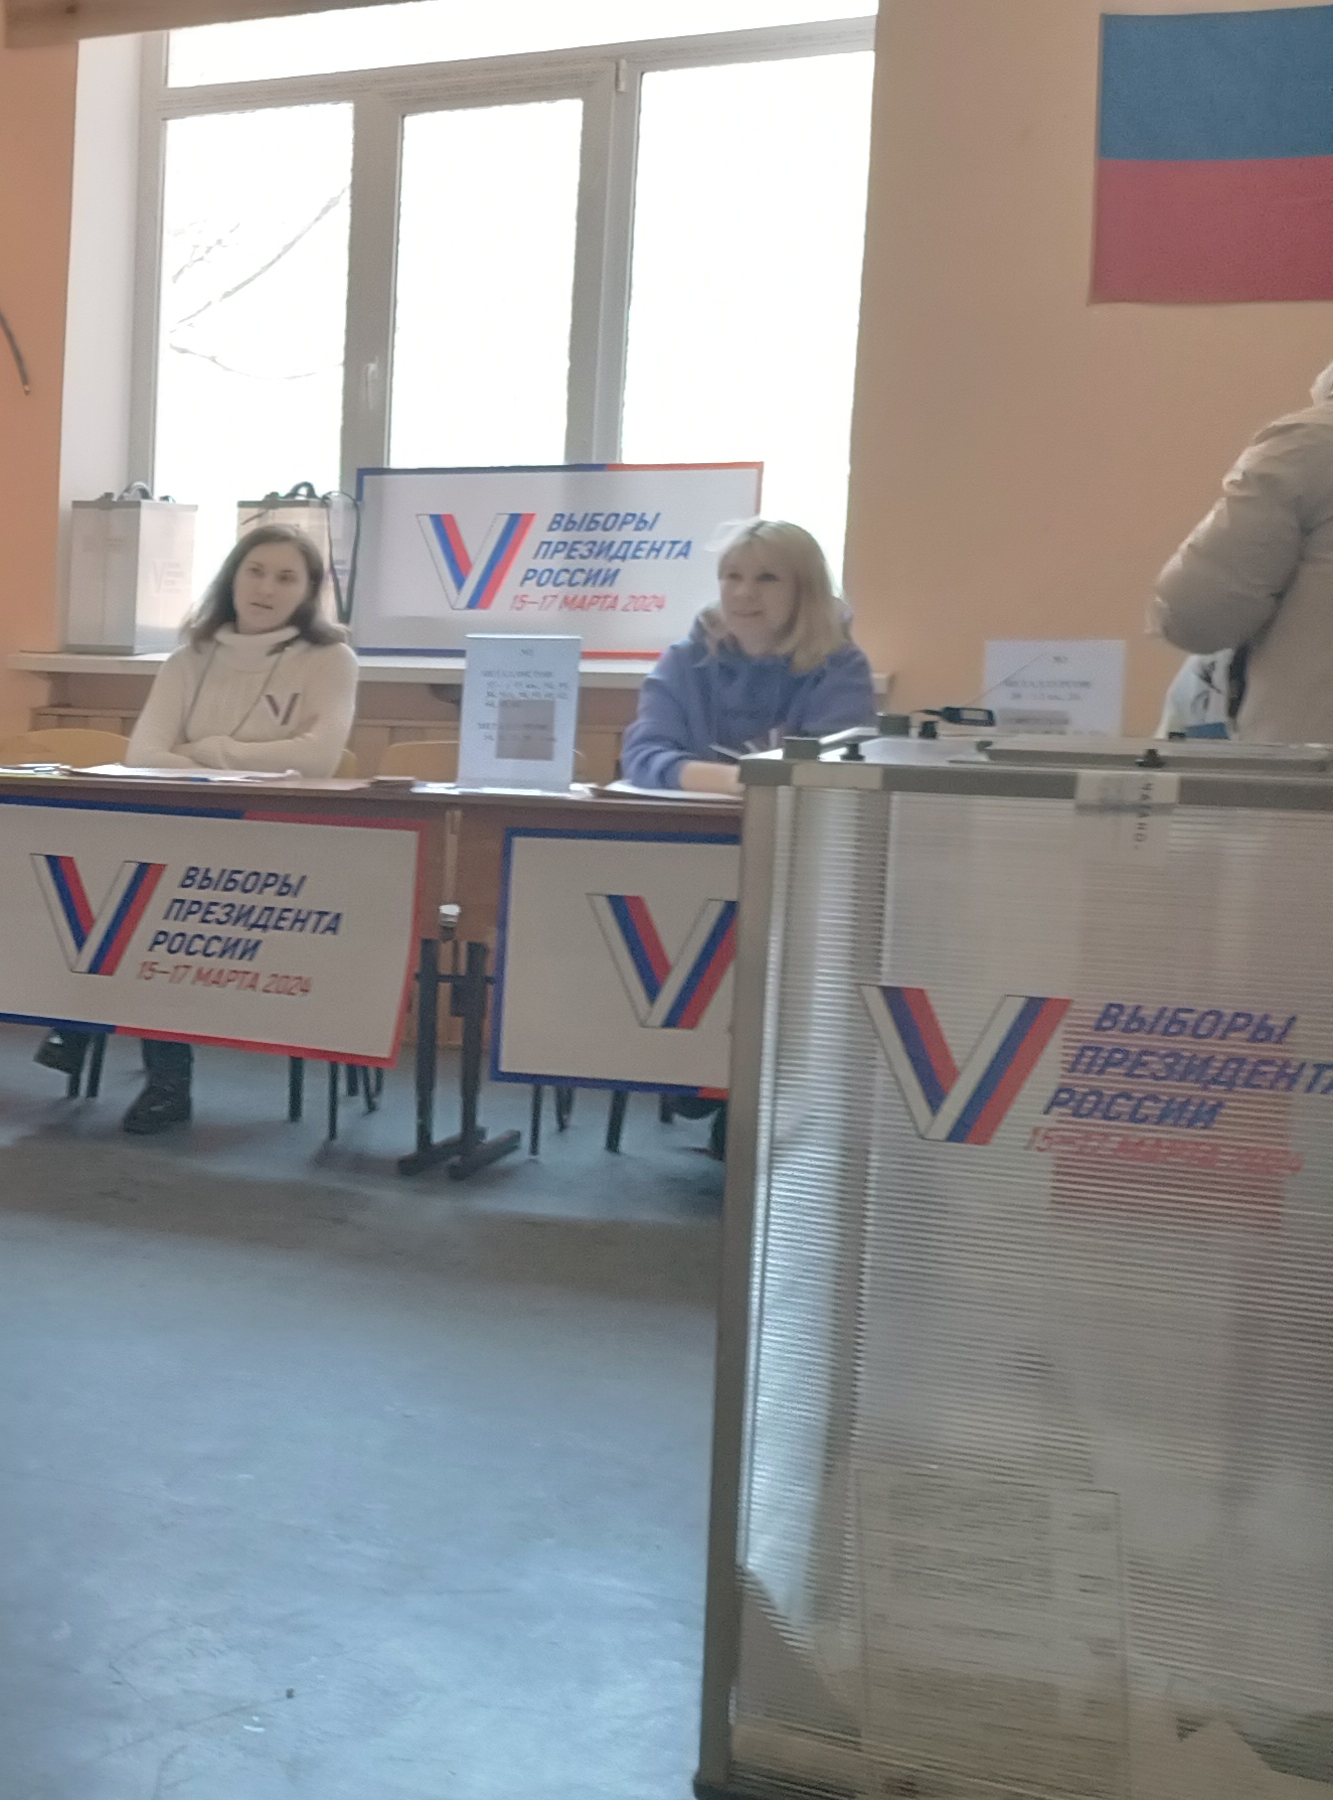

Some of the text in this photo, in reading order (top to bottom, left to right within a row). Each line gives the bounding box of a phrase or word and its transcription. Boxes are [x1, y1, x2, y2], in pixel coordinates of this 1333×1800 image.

[546, 512, 661, 533] ВЫБОРЫ
[532, 540, 693, 562] ПРЕЗИДЕНТА
[519, 567, 622, 588] РОССИИ
[559, 594, 620, 611] МАРТА
[621, 594, 667, 612] 2024
[178, 866, 308, 898] ВЫБОРЫ
[162, 898, 344, 936] ПРЕЗИДЕНТА
[148, 930, 263, 962] РОССИИ
[191, 966, 261, 992] МАРТА
[262, 973, 312, 997] 2024
[1093, 1002, 1298, 1044] ВЫБОРЫ
[1065, 1044, 1333, 1096] ПРЕЗИДЕНТ
[1043, 1087, 1226, 1130] РОССИИ
